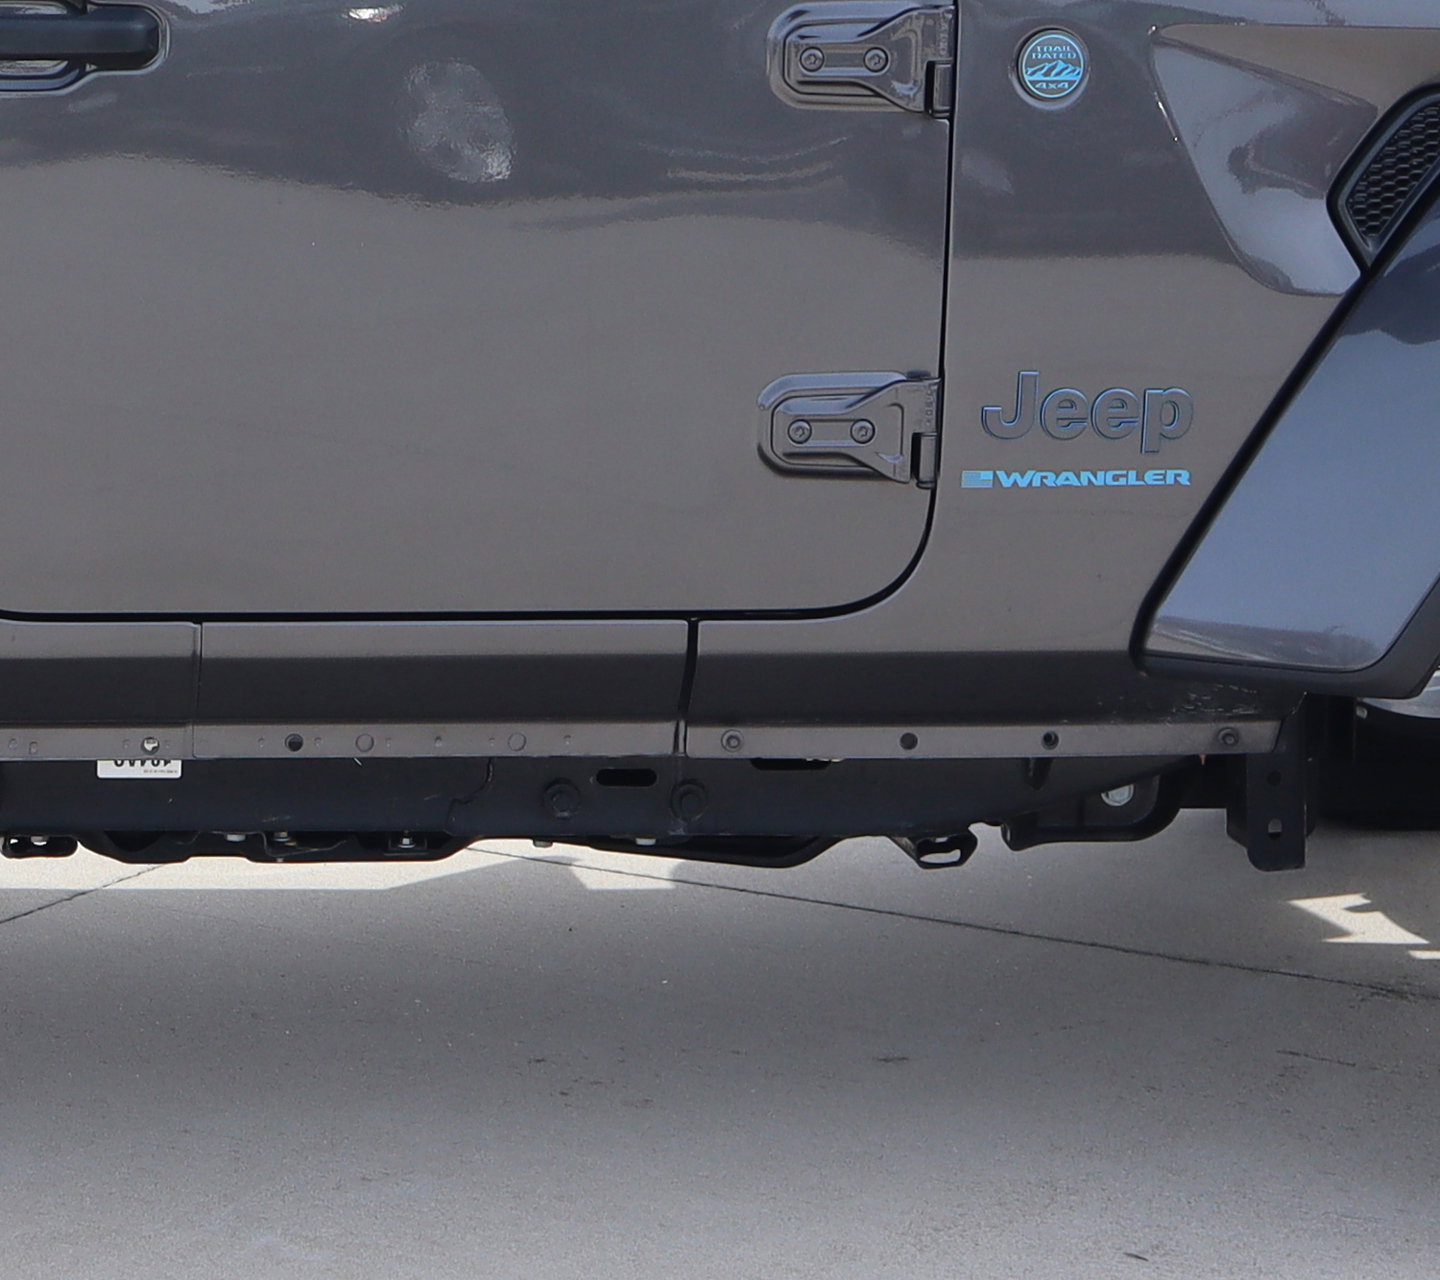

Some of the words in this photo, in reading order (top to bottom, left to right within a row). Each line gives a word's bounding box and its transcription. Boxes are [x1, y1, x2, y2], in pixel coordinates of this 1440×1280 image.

[1036, 45, 1071, 53] TRAIL
[1031, 52, 1077, 60] RATED
[980, 370, 1194, 454] Jeep
[996, 469, 1192, 488] WRANGLER
